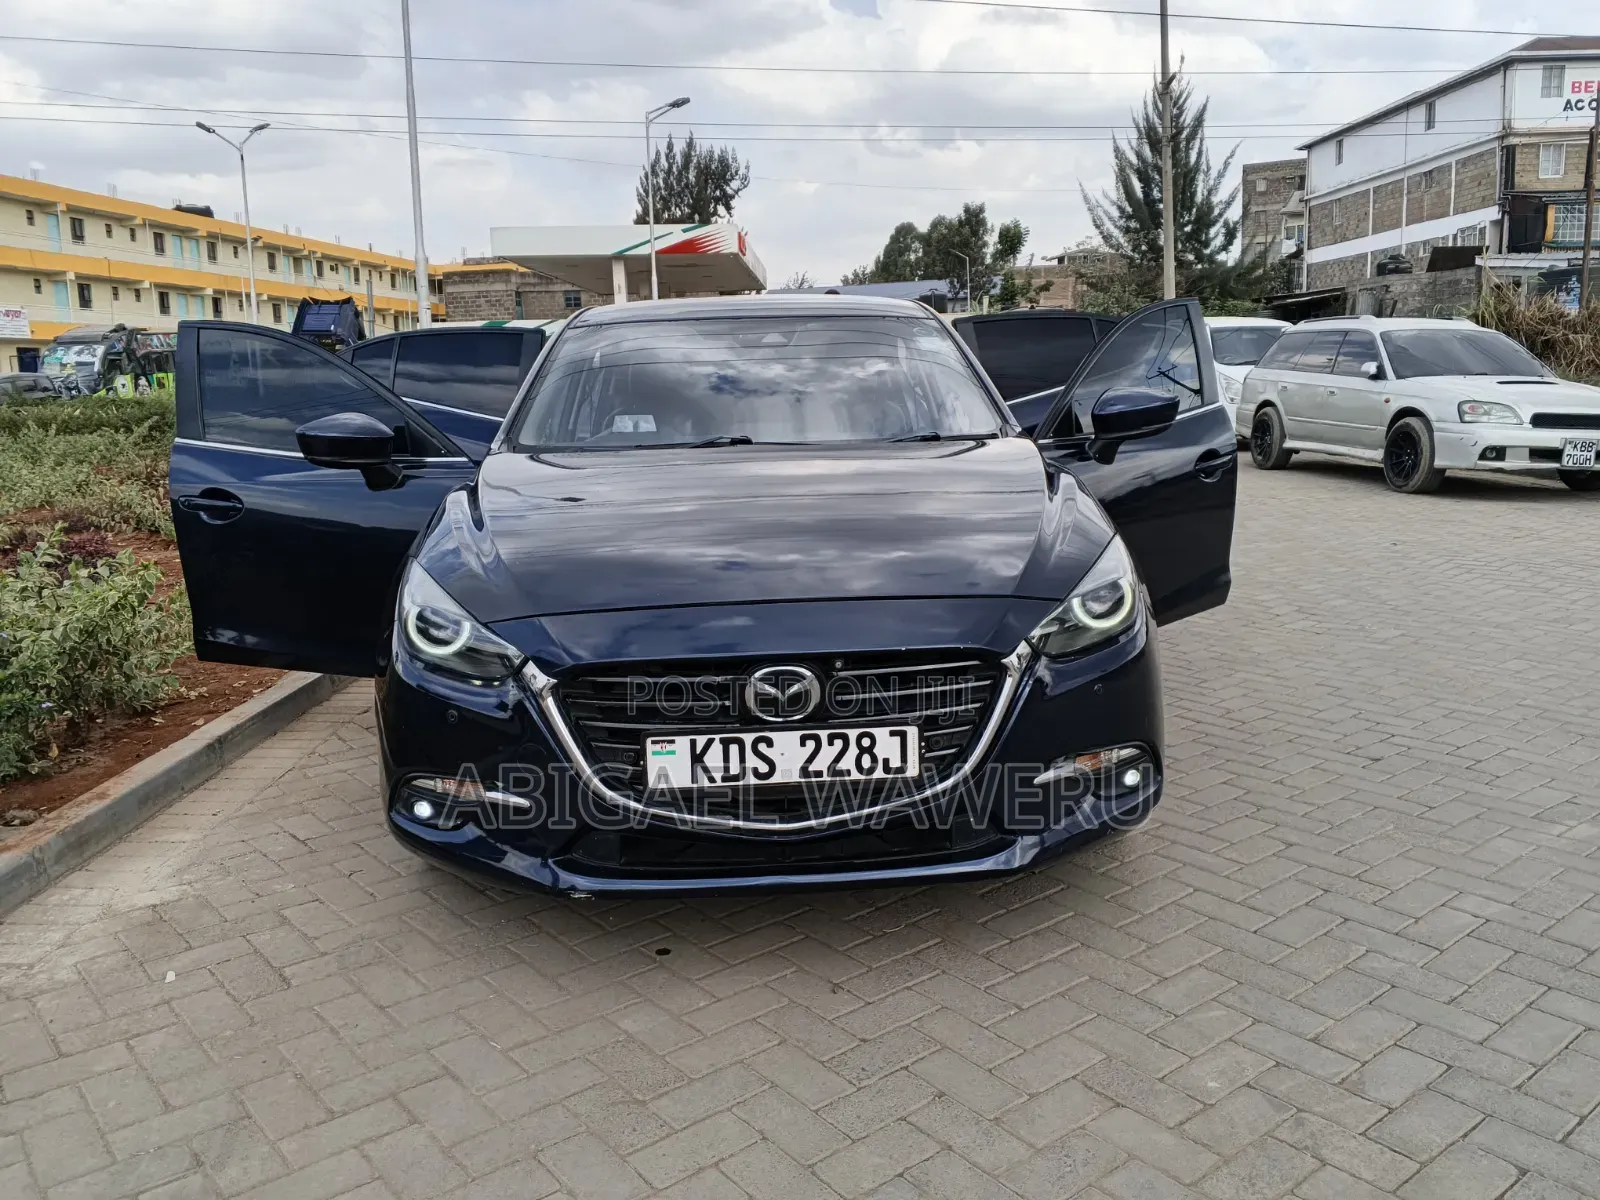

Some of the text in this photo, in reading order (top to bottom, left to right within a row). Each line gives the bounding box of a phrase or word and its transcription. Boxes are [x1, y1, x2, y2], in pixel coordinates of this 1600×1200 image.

[1571, 80, 1600, 94] BE
[1572, 441, 1594, 452] KBB
[1565, 454, 1592, 465] 700H
[689, 735, 777, 784] KDS
[798, 729, 908, 779] 228J
